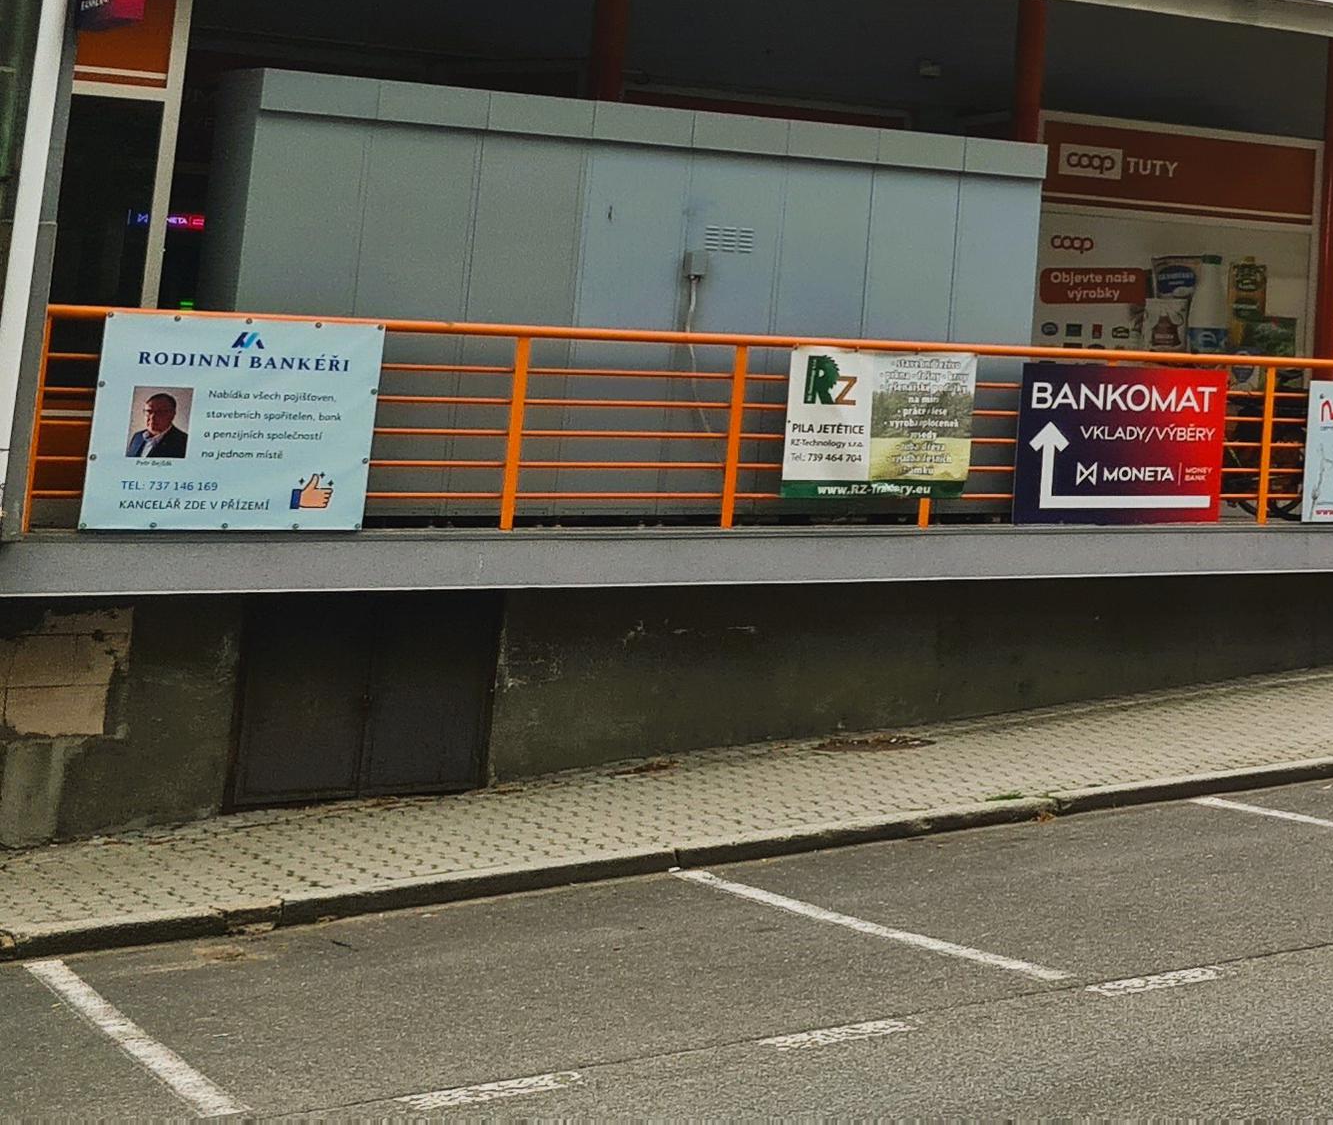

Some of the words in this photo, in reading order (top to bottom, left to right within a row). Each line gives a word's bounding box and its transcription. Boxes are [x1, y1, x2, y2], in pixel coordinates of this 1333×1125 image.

[1066, 151, 1116, 175] coop
[1126, 157, 1179, 177] TUTY
[1050, 234, 1094, 254] coop
[1050, 271, 1103, 286] Objevte
[1105, 271, 1136, 283] naše
[1067, 286, 1120, 301] výrobky
[138, 350, 243, 368] RODINNÍ
[249, 353, 350, 373] BANKÉŘI
[208, 390, 250, 400] Nabídka
[252, 390, 281, 400] všech
[1031, 381, 1218, 413] BANKOMAT
[205, 410, 261, 420] stavebních
[318, 412, 342, 421] bank
[213, 429, 264, 441] penzijních
[266, 431, 323, 441] společností
[791, 422, 815, 434] PILA
[1080, 422, 1217, 443] VKLADY/VÝBĚRY
[216, 450, 254, 461] jednom
[256, 450, 284, 460] místě
[1103, 466, 1175, 482] MONETA
[120, 480, 145, 490] TEL:
[149, 481, 171, 491] 737
[174, 481, 195, 491] 146
[197, 481, 218, 492] 169
[118, 498, 181, 510] KANCELÁŘ
[184, 500, 207, 510] ZDE
[210, 500, 218, 510] V
[220, 498, 272, 511] PŘÍZEMÍ
